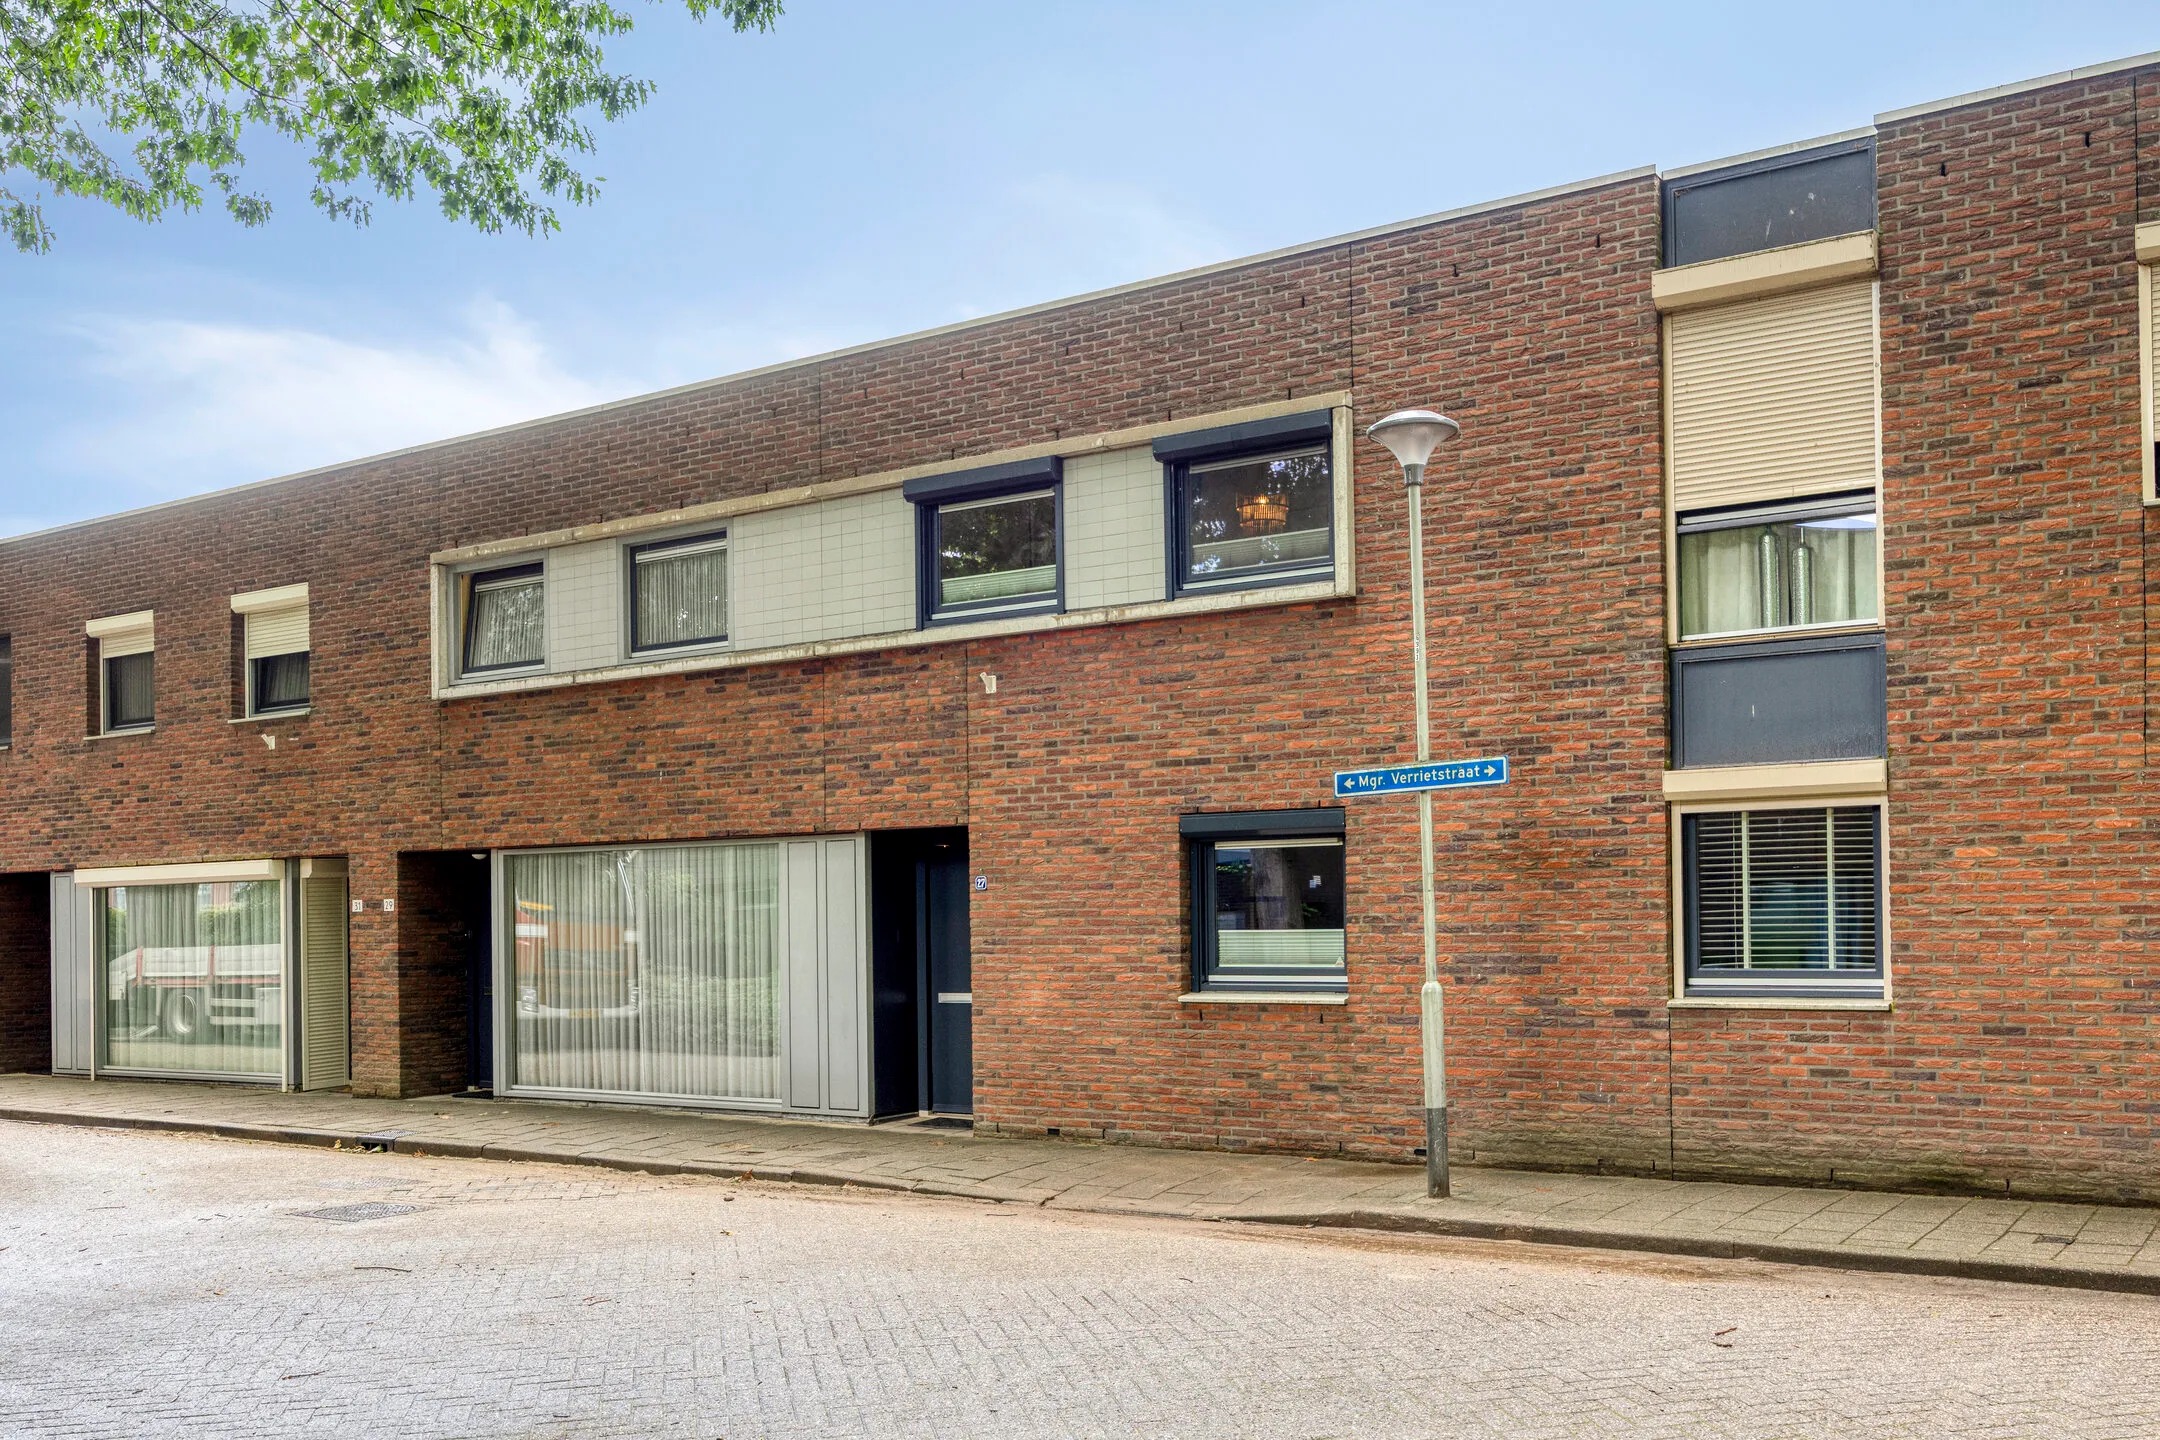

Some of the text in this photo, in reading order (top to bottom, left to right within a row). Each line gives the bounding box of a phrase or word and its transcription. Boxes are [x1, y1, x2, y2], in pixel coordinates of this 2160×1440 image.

[1358, 765, 1480, 790] Mgr. Verrietstraat
[385, 901, 393, 910] 29
